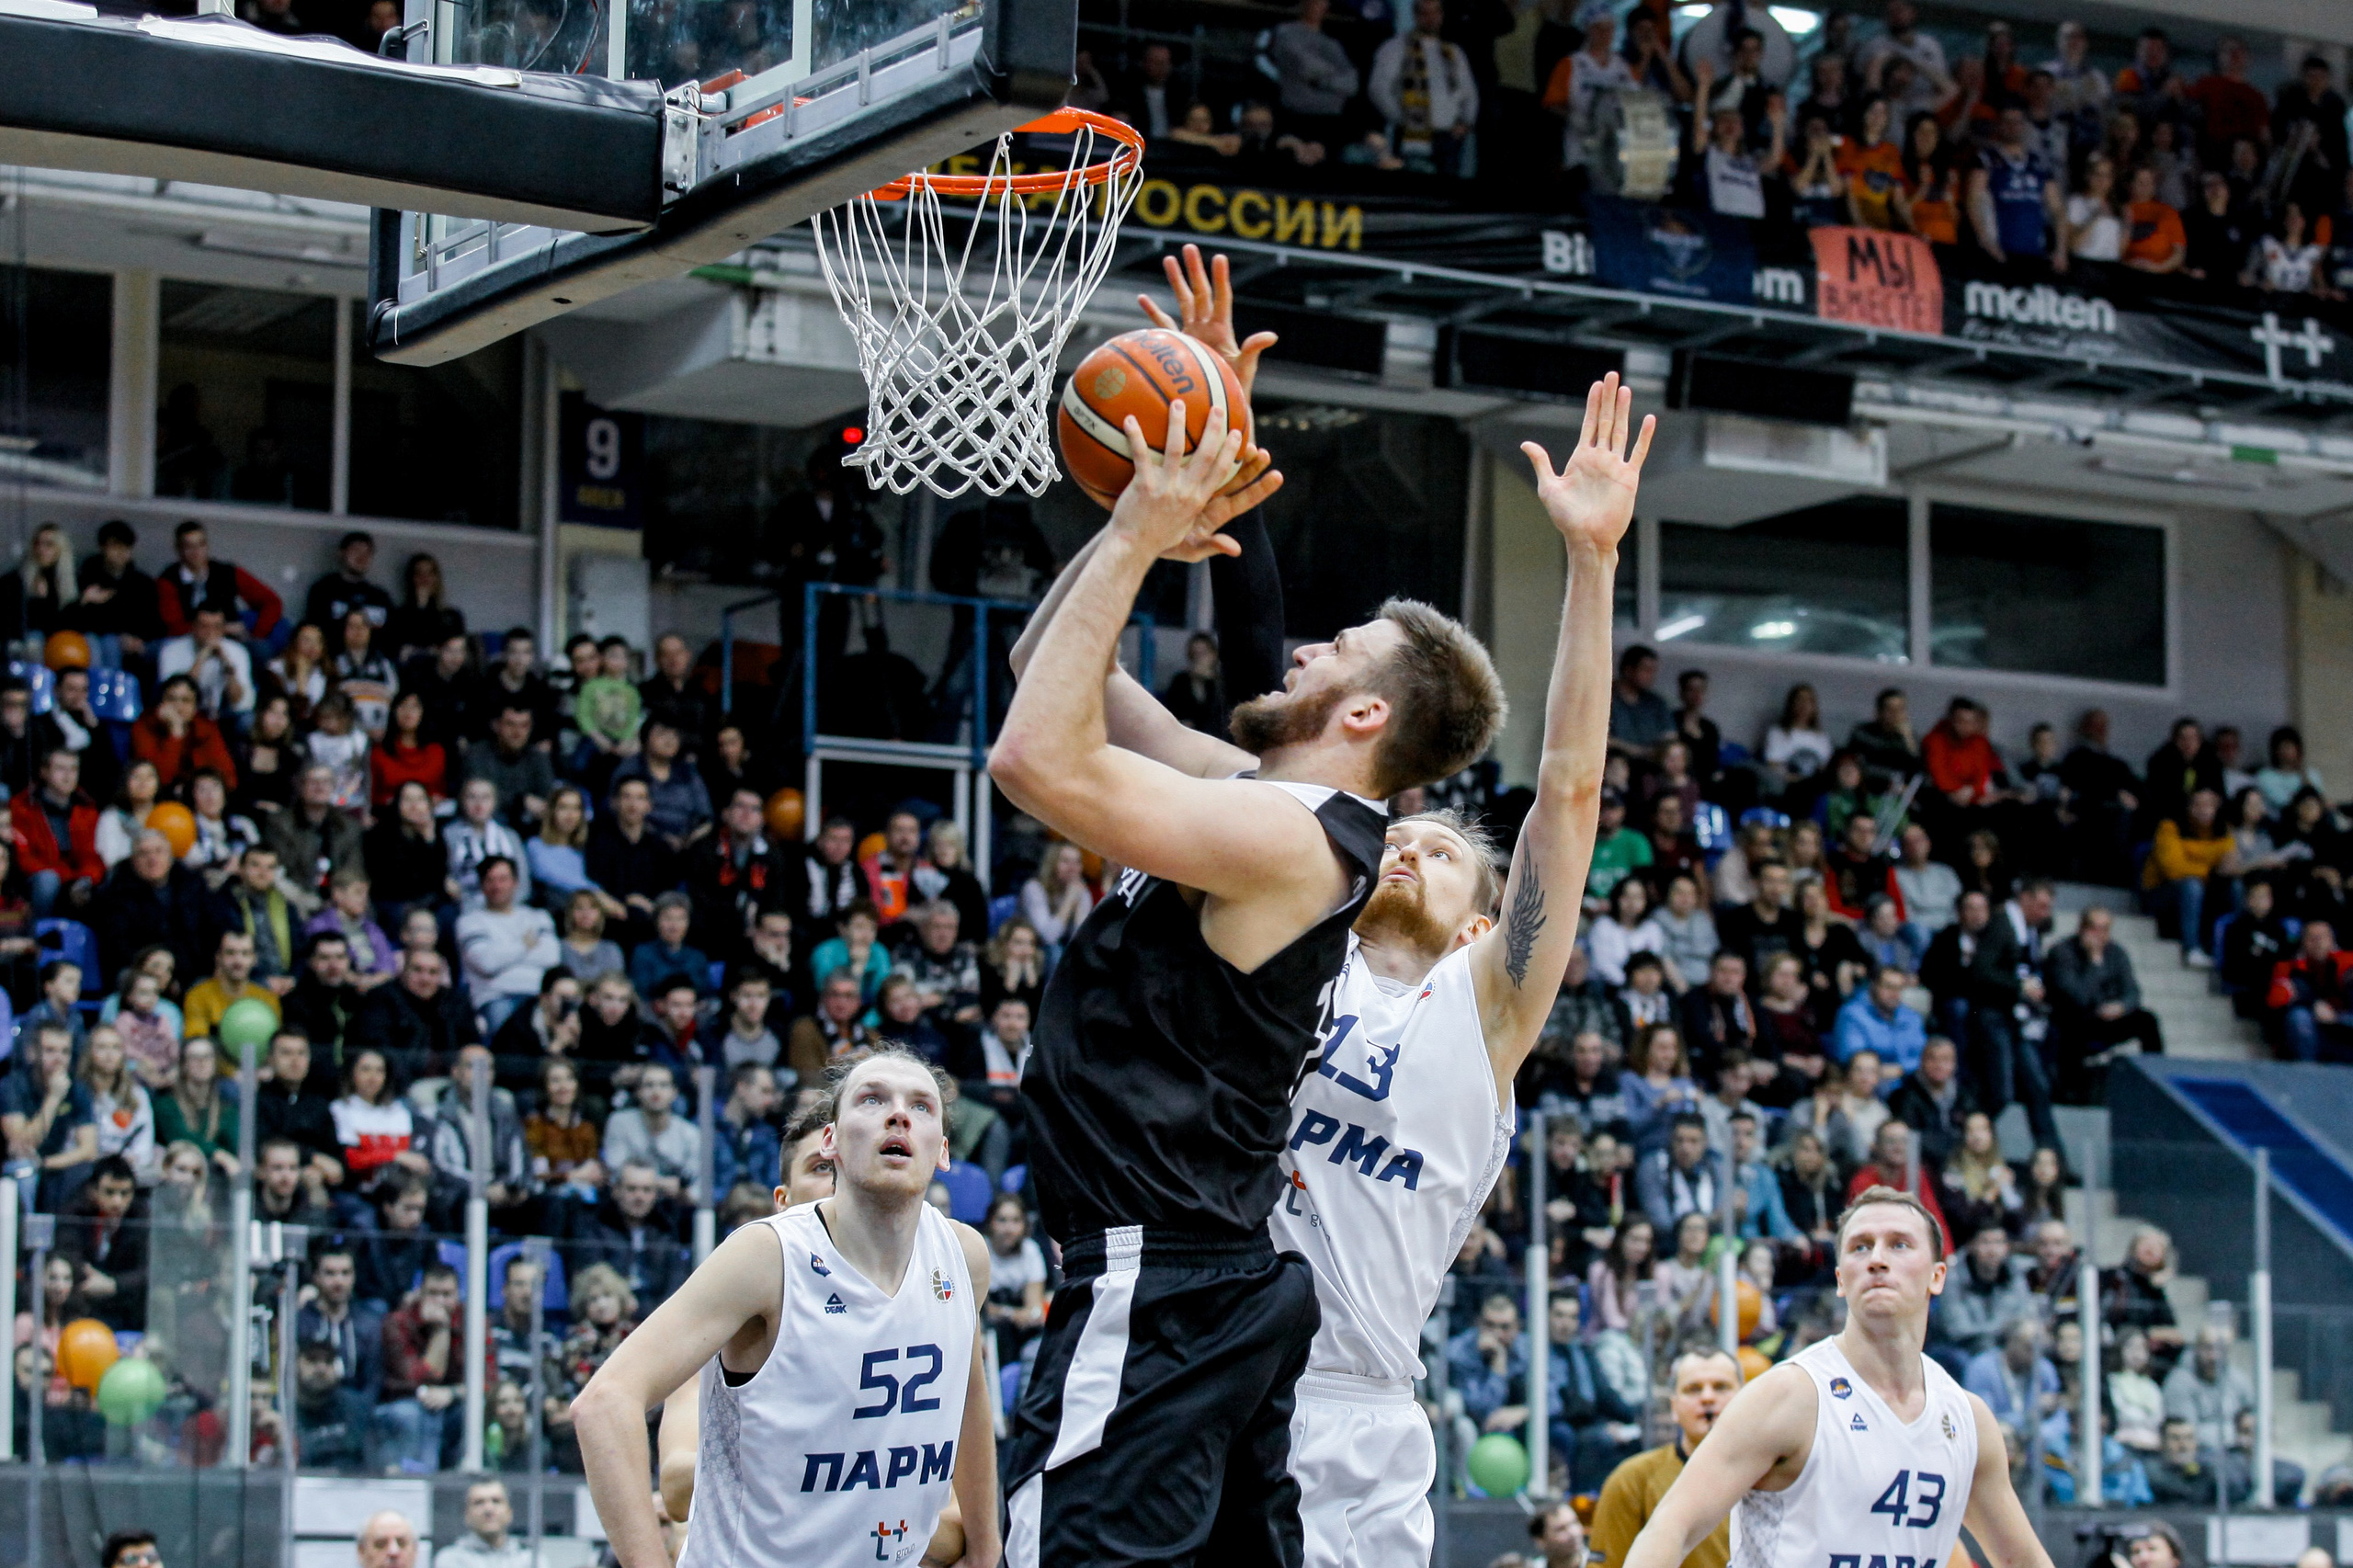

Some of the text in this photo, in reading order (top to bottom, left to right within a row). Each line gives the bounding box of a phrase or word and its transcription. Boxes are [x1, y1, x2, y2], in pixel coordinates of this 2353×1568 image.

[1097, 177, 1364, 251] РОССИИ
[1964, 280, 2117, 334] molten
[586, 418, 621, 480] 9
[1289, 1108, 1425, 1191] РМА
[824, 1305, 847, 1314] PEAK
[852, 1343, 943, 1419] 52
[801, 1440, 954, 1493] ПАРМ
[1870, 1469, 1946, 1529] 43
